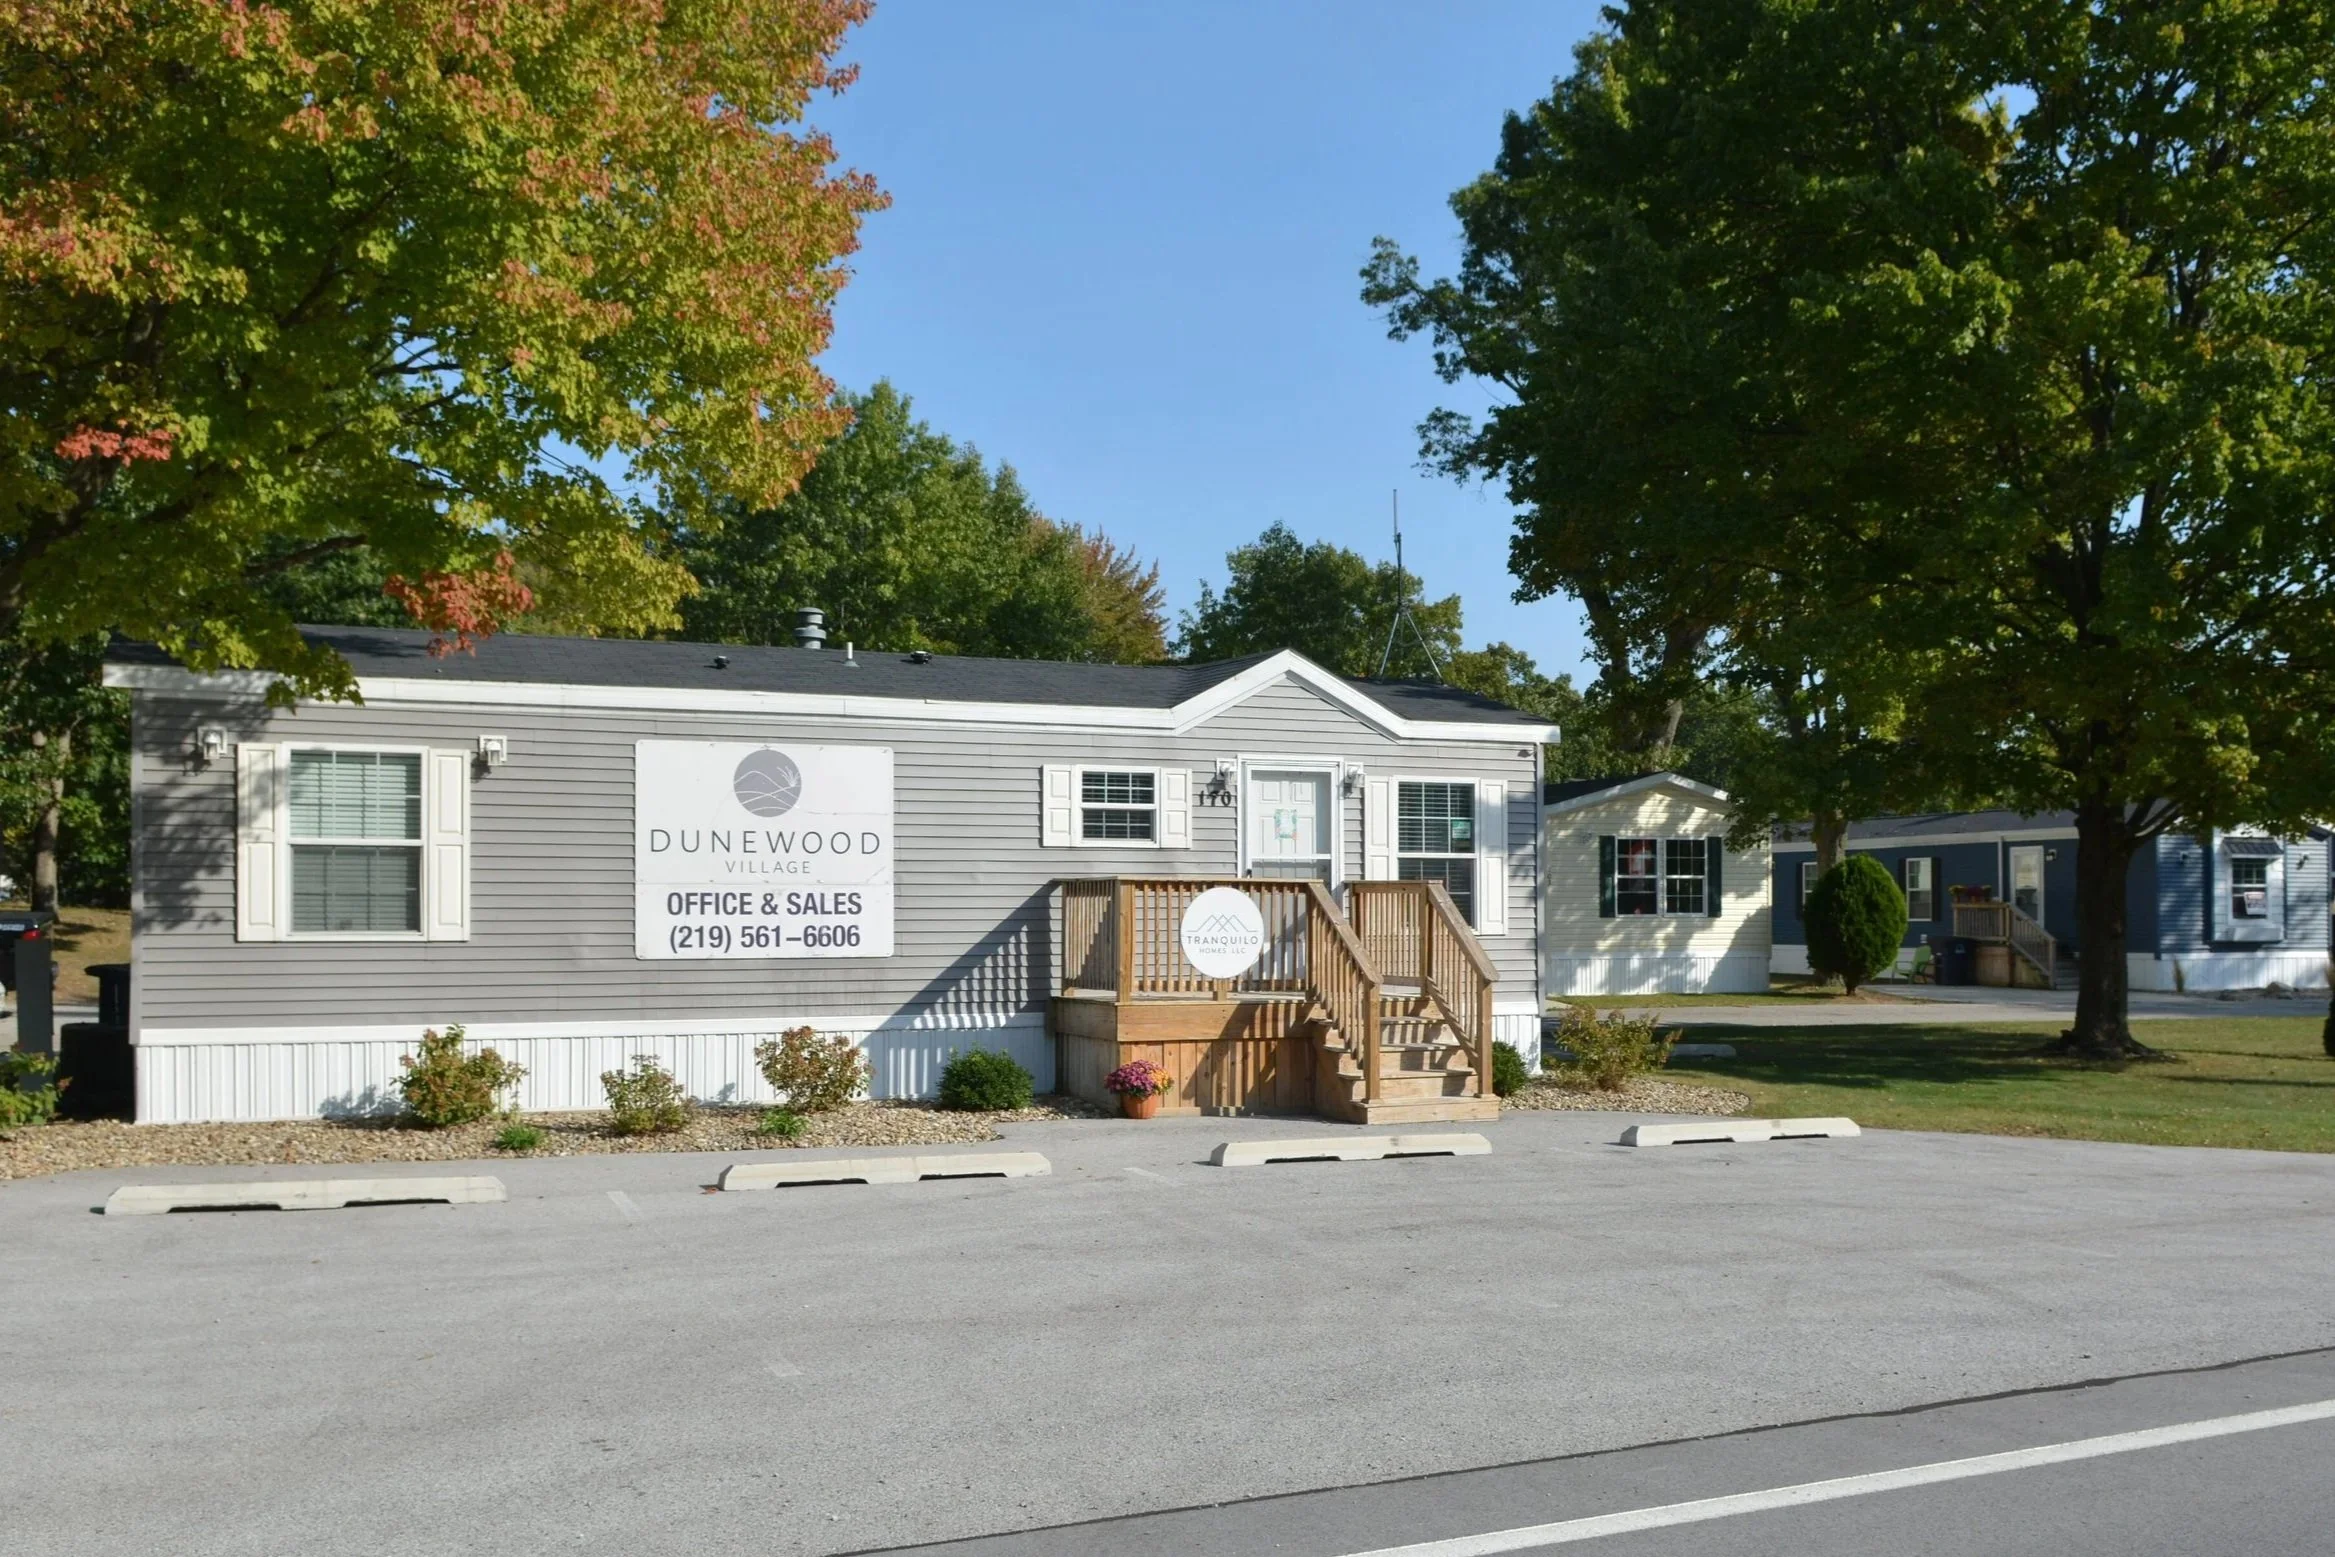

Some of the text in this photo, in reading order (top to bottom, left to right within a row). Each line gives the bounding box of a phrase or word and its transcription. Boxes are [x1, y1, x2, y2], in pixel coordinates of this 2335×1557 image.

[650, 829, 880, 855] DUNEWOOD
[725, 861, 811, 874] VILLAGE
[667, 892, 863, 916] OFFICE & SALES
[669, 925, 732, 954] (219)
[1186, 935, 1259, 947] TRANQUILO
